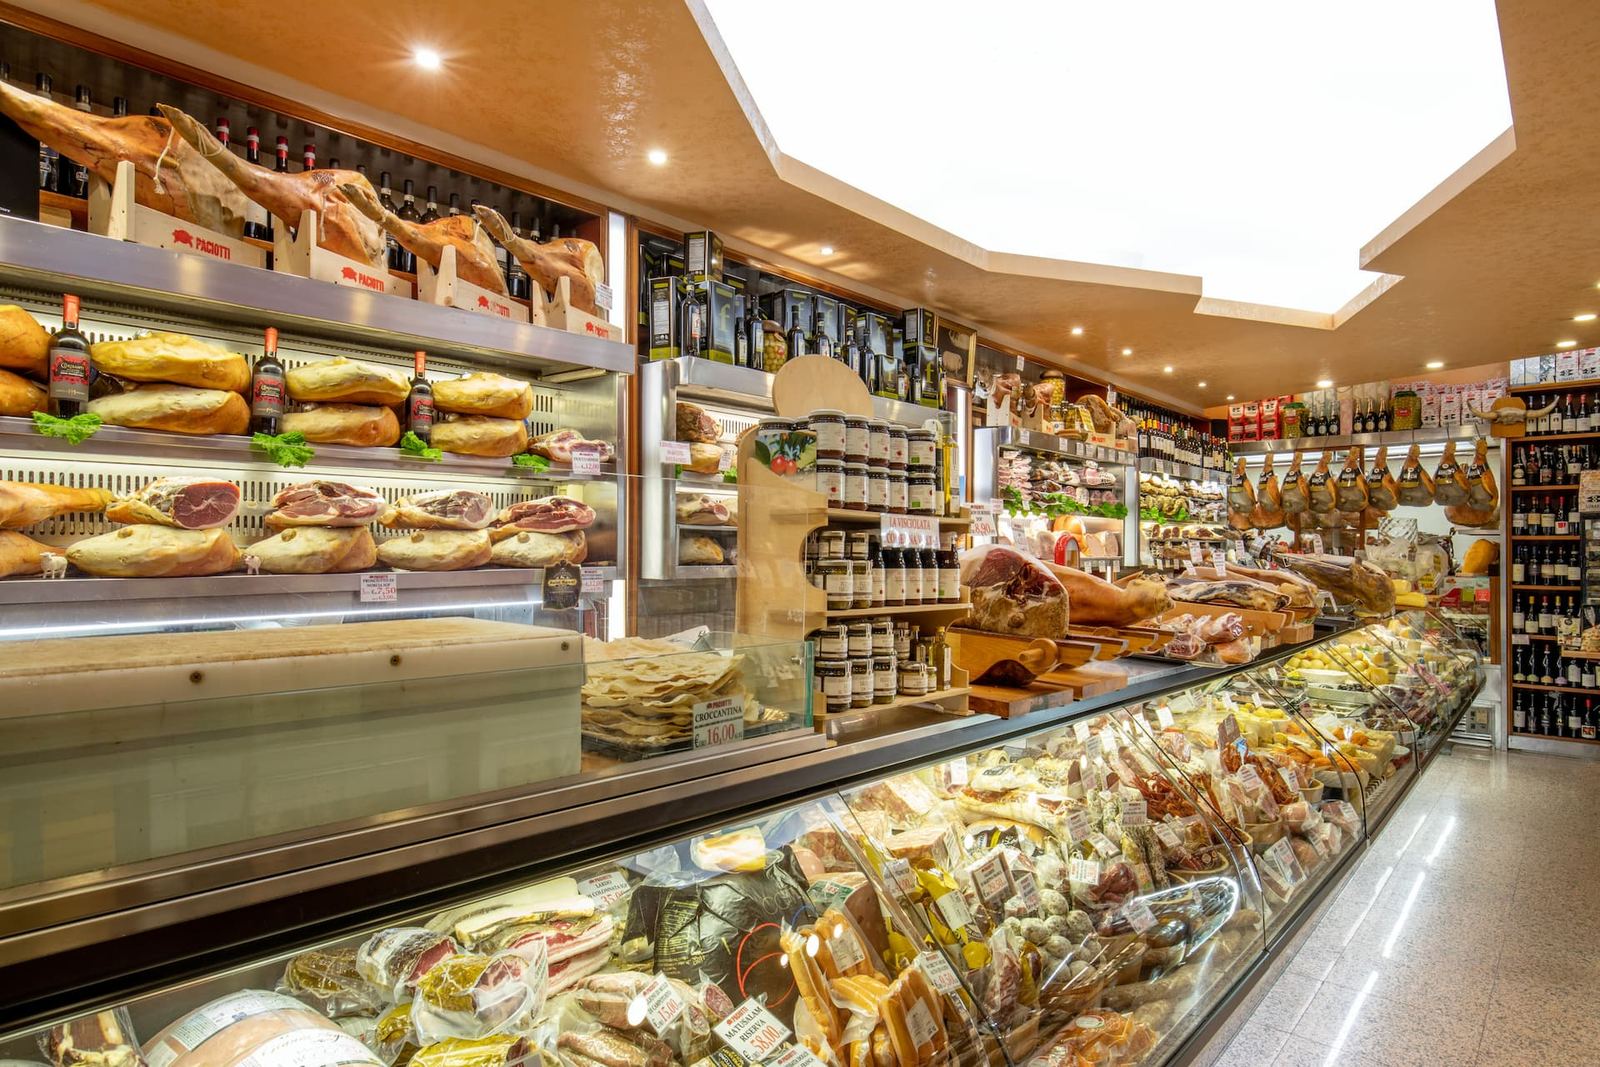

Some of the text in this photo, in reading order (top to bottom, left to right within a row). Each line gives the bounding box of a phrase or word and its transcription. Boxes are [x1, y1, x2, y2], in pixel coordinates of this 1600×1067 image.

[196, 236, 231, 260] PACIOTTI
[889, 517, 897, 527] LA
[695, 706, 742, 722] CROCCANTINA
[707, 723, 735, 745] 16,00
[724, 1006, 763, 1040] MATUSALAM
[739, 1019, 767, 1042] RISERVA
[749, 1025, 781, 1054] 58,00
